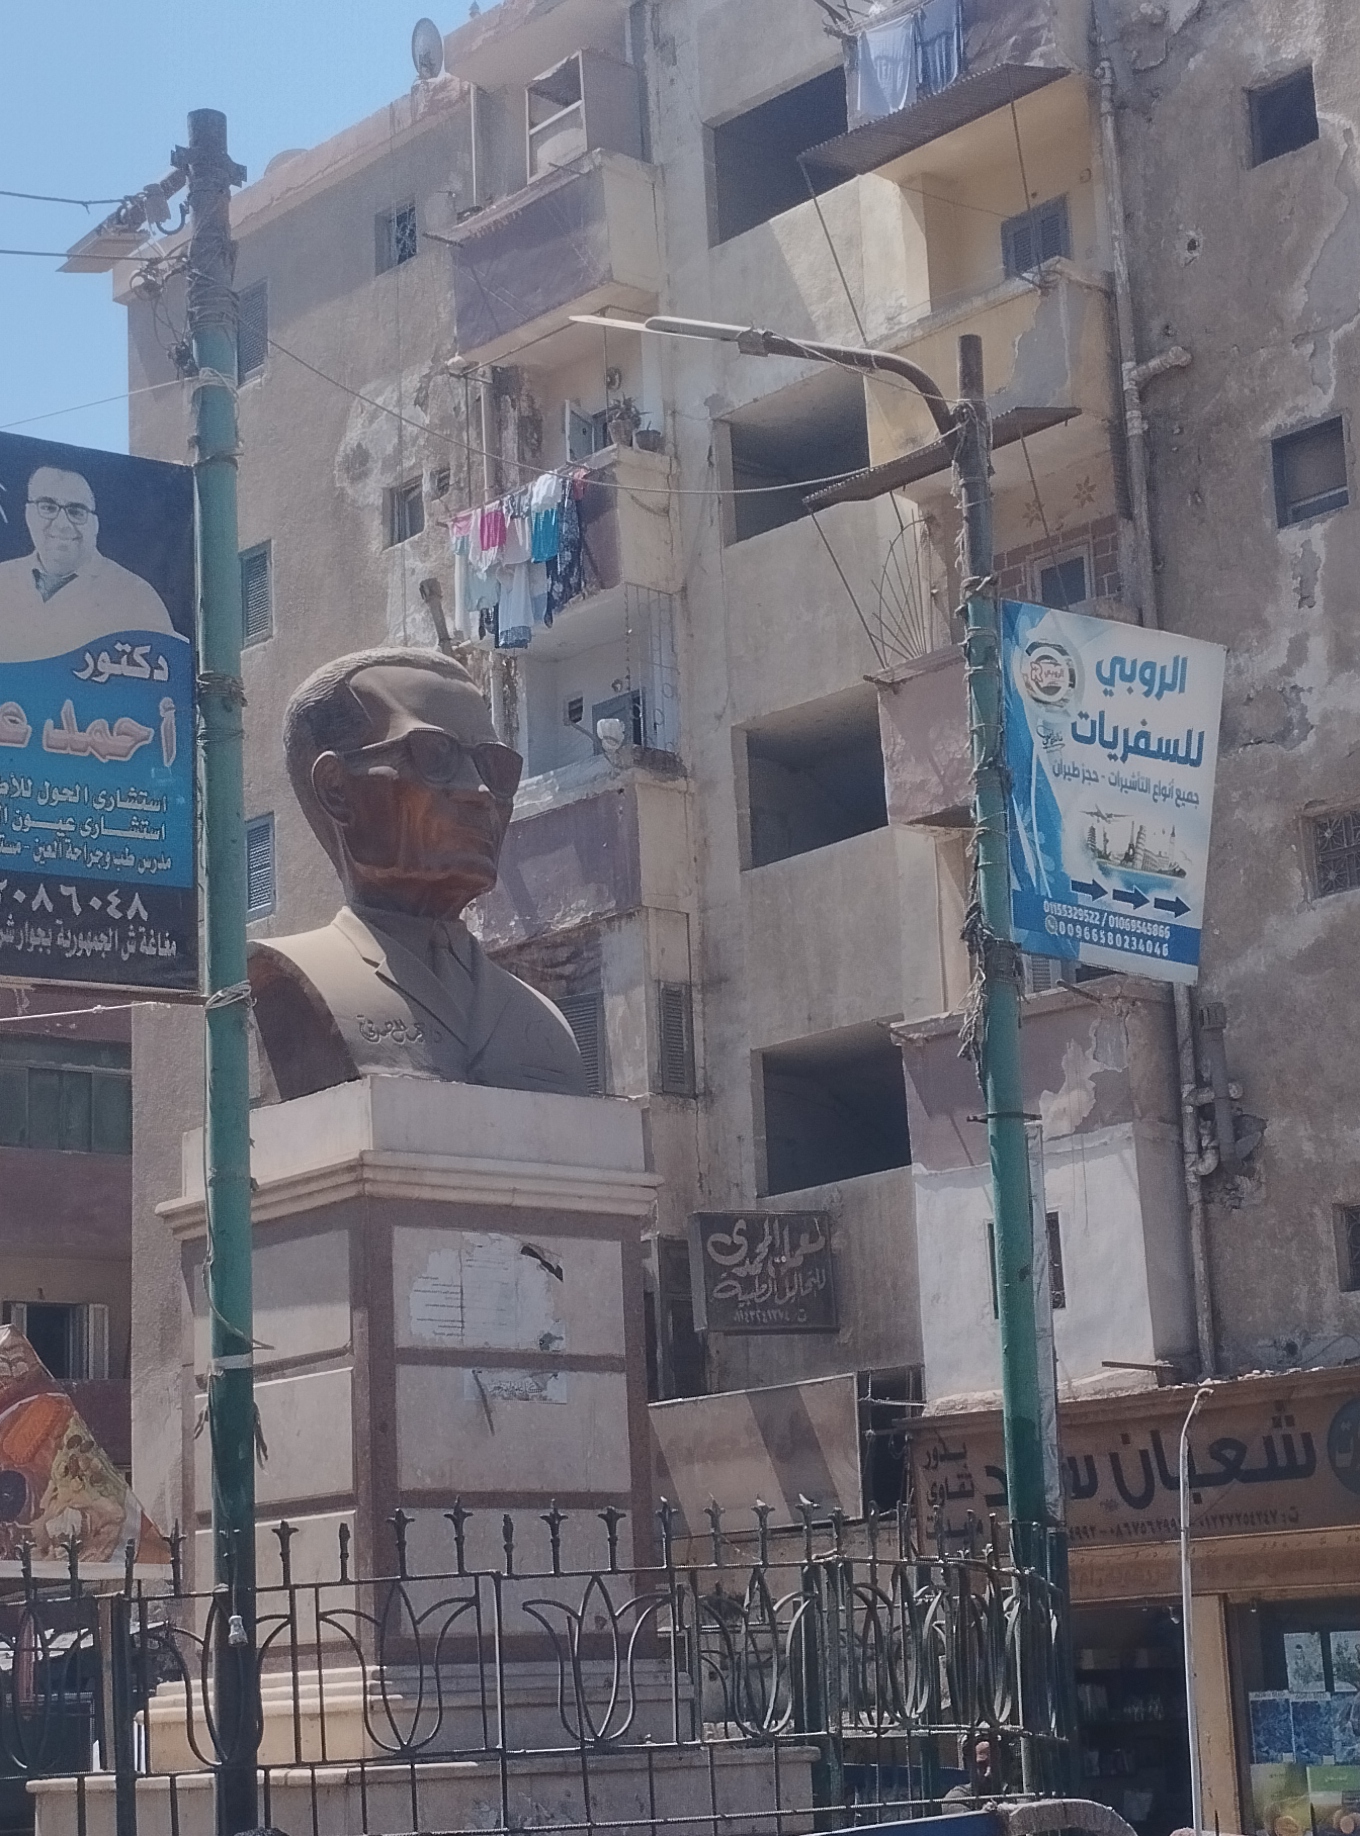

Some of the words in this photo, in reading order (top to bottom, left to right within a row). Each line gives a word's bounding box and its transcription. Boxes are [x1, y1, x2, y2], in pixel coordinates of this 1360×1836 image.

[73, 642, 169, 682] دكتور
[1095, 653, 1189, 702] الروبي
[43, 697, 177, 767] أحمد
[1070, 708, 1206, 768] للسفريات
[1052, 758, 1080, 782] طيران
[1081, 764, 1099, 785] حجز
[1108, 770, 1151, 795] التأشيرات
[37, 780, 89, 806] الحول
[92, 786, 167, 814] استشارى
[1152, 778, 1174, 803] أنواع
[1175, 788, 1201, 809] جميع
[11, 809, 76, 837] عيون
[32, 837, 62, 865] العين
[65, 837, 111, 870] وجراحة
[112, 847, 135, 871] طب
[137, 851, 172, 874] مدرس
[15, 920, 52, 954] بجوار
[55, 919, 118, 958] الجمهورية
[121, 924, 137, 961] ش
[139, 926, 177, 958] مغاغة
[1107, 1399, 1318, 1511] شعبان
